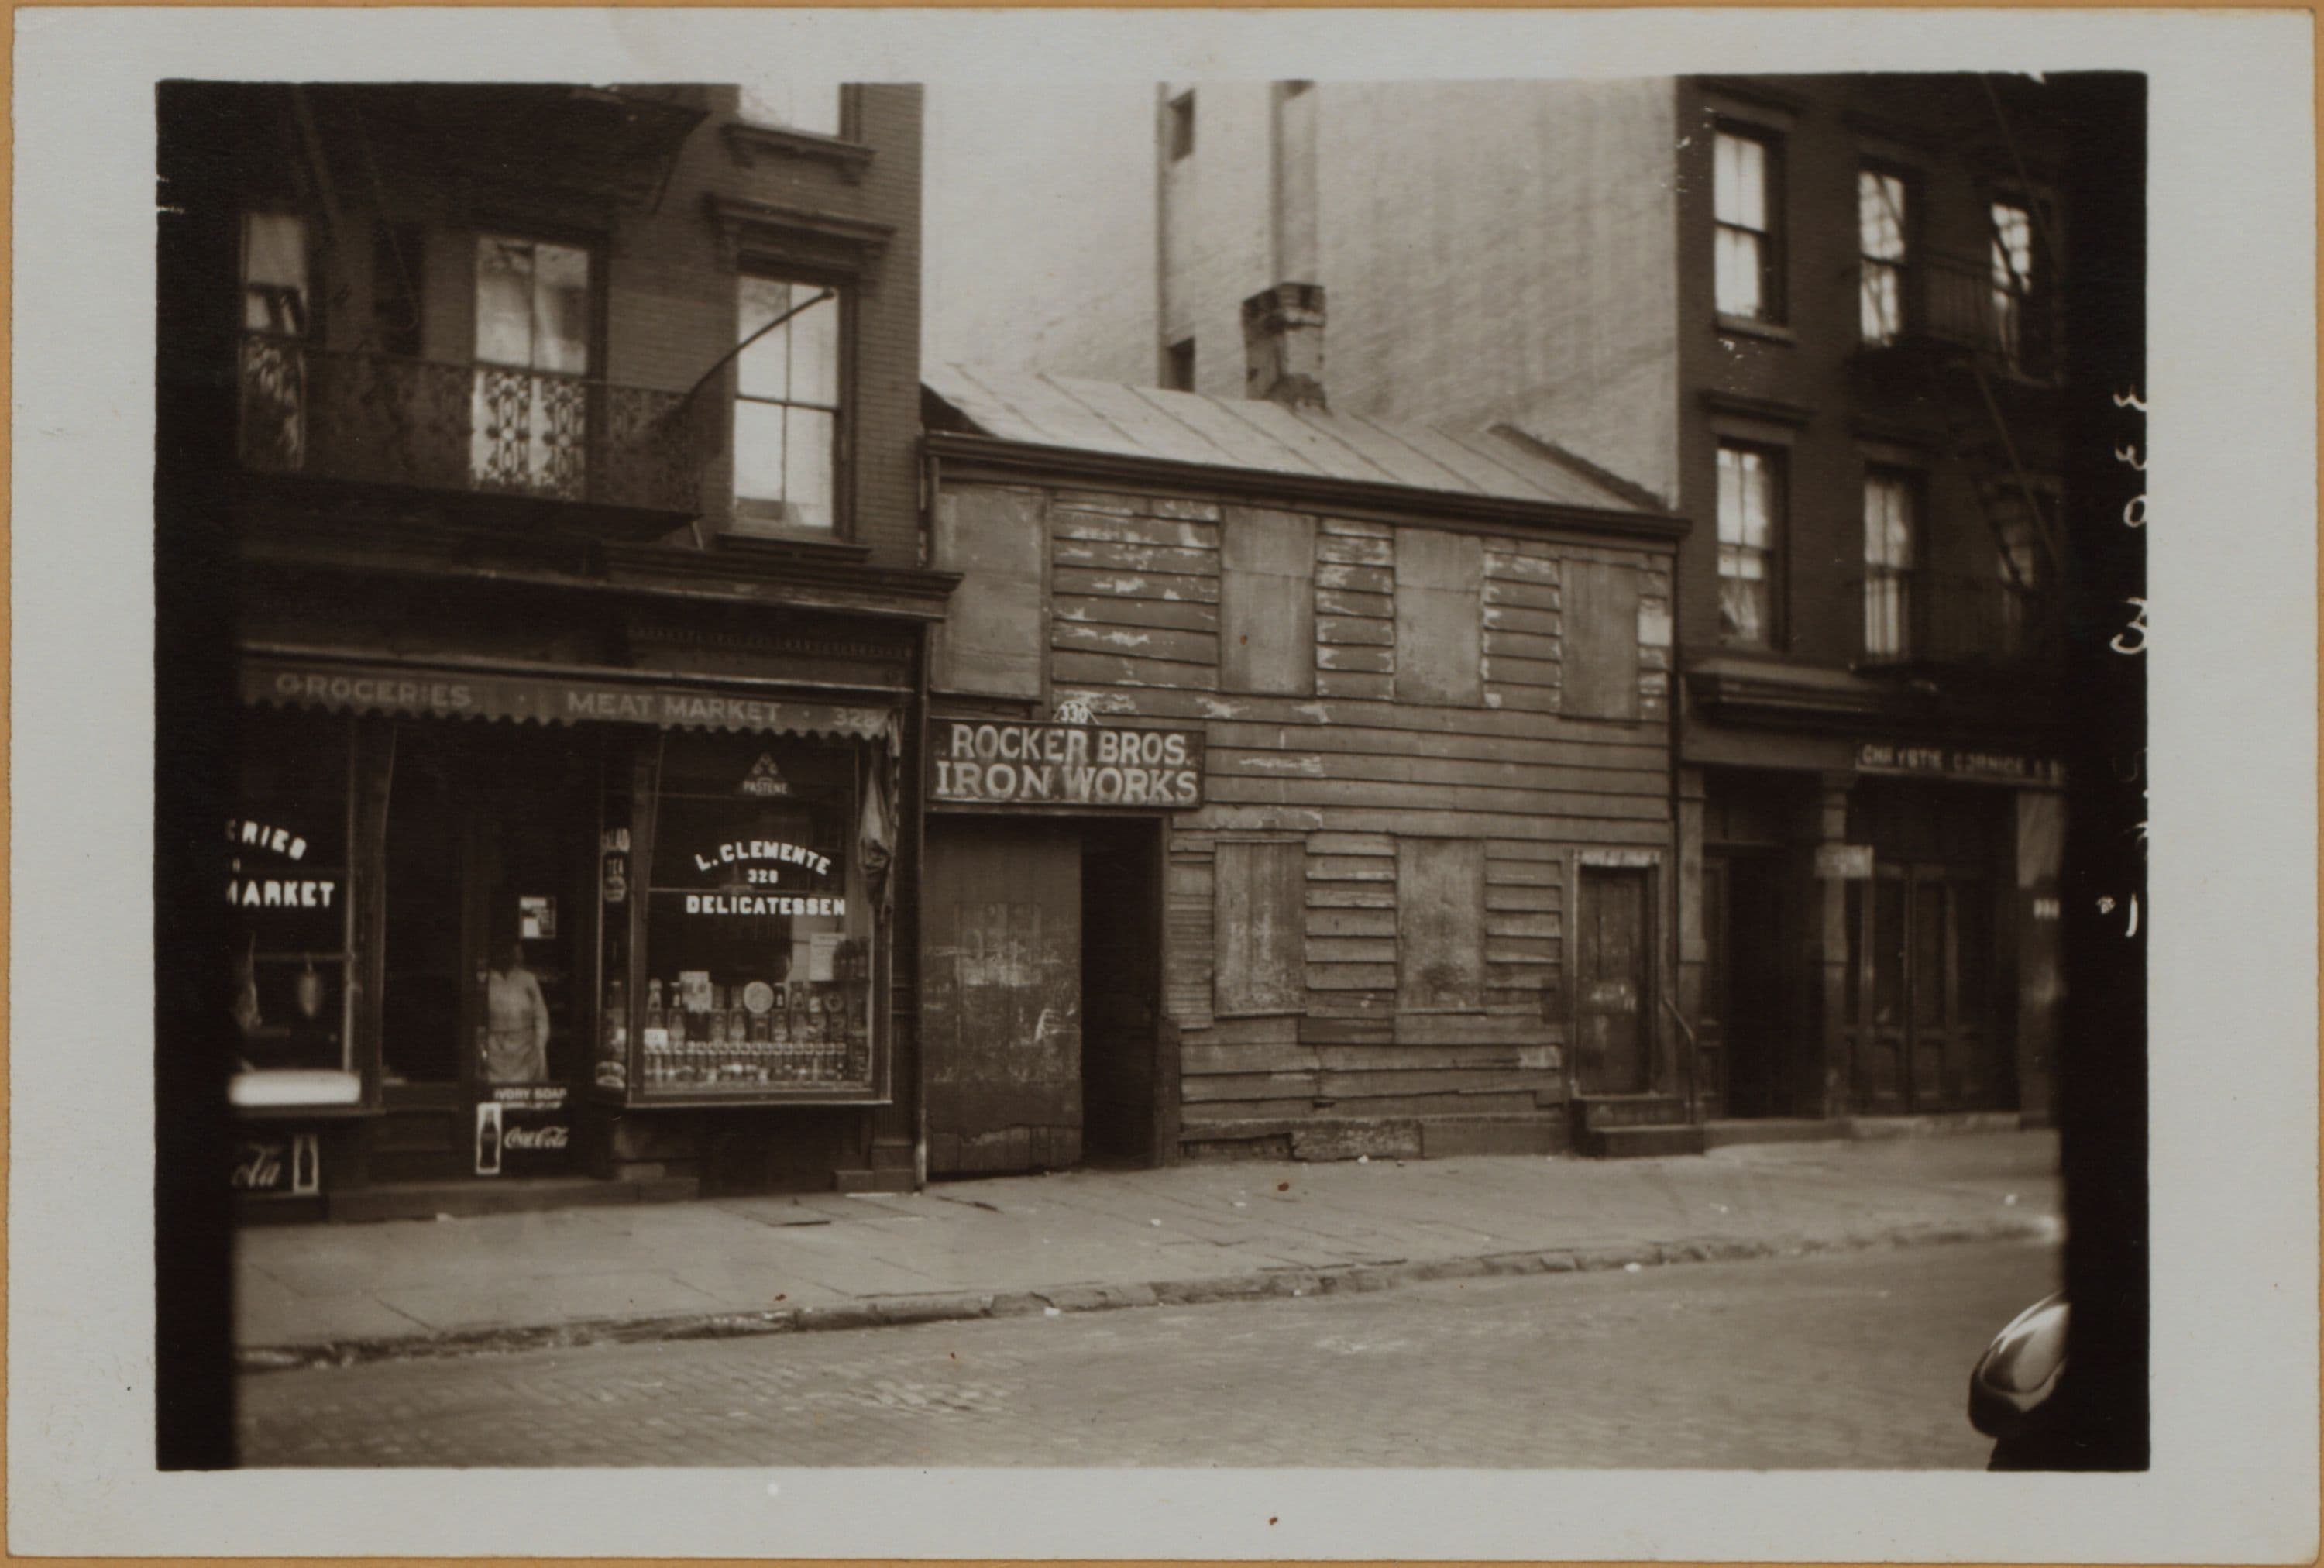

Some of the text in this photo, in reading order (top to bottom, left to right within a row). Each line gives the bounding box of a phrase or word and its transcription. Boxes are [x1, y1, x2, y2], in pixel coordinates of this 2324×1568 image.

[275, 672, 473, 708] GROCERIES
[566, 690, 654, 717] MEAT
[664, 695, 782, 724] MARKET
[1058, 703, 1088, 724] 330
[951, 723, 1195, 767] ROCKER BROS.
[936, 760, 1198, 804] IRON WORKS
[694, 840, 831, 875] L. CLEMENTE
[747, 868, 779, 884] 328
[686, 894, 847, 916] DELICATESSEN
